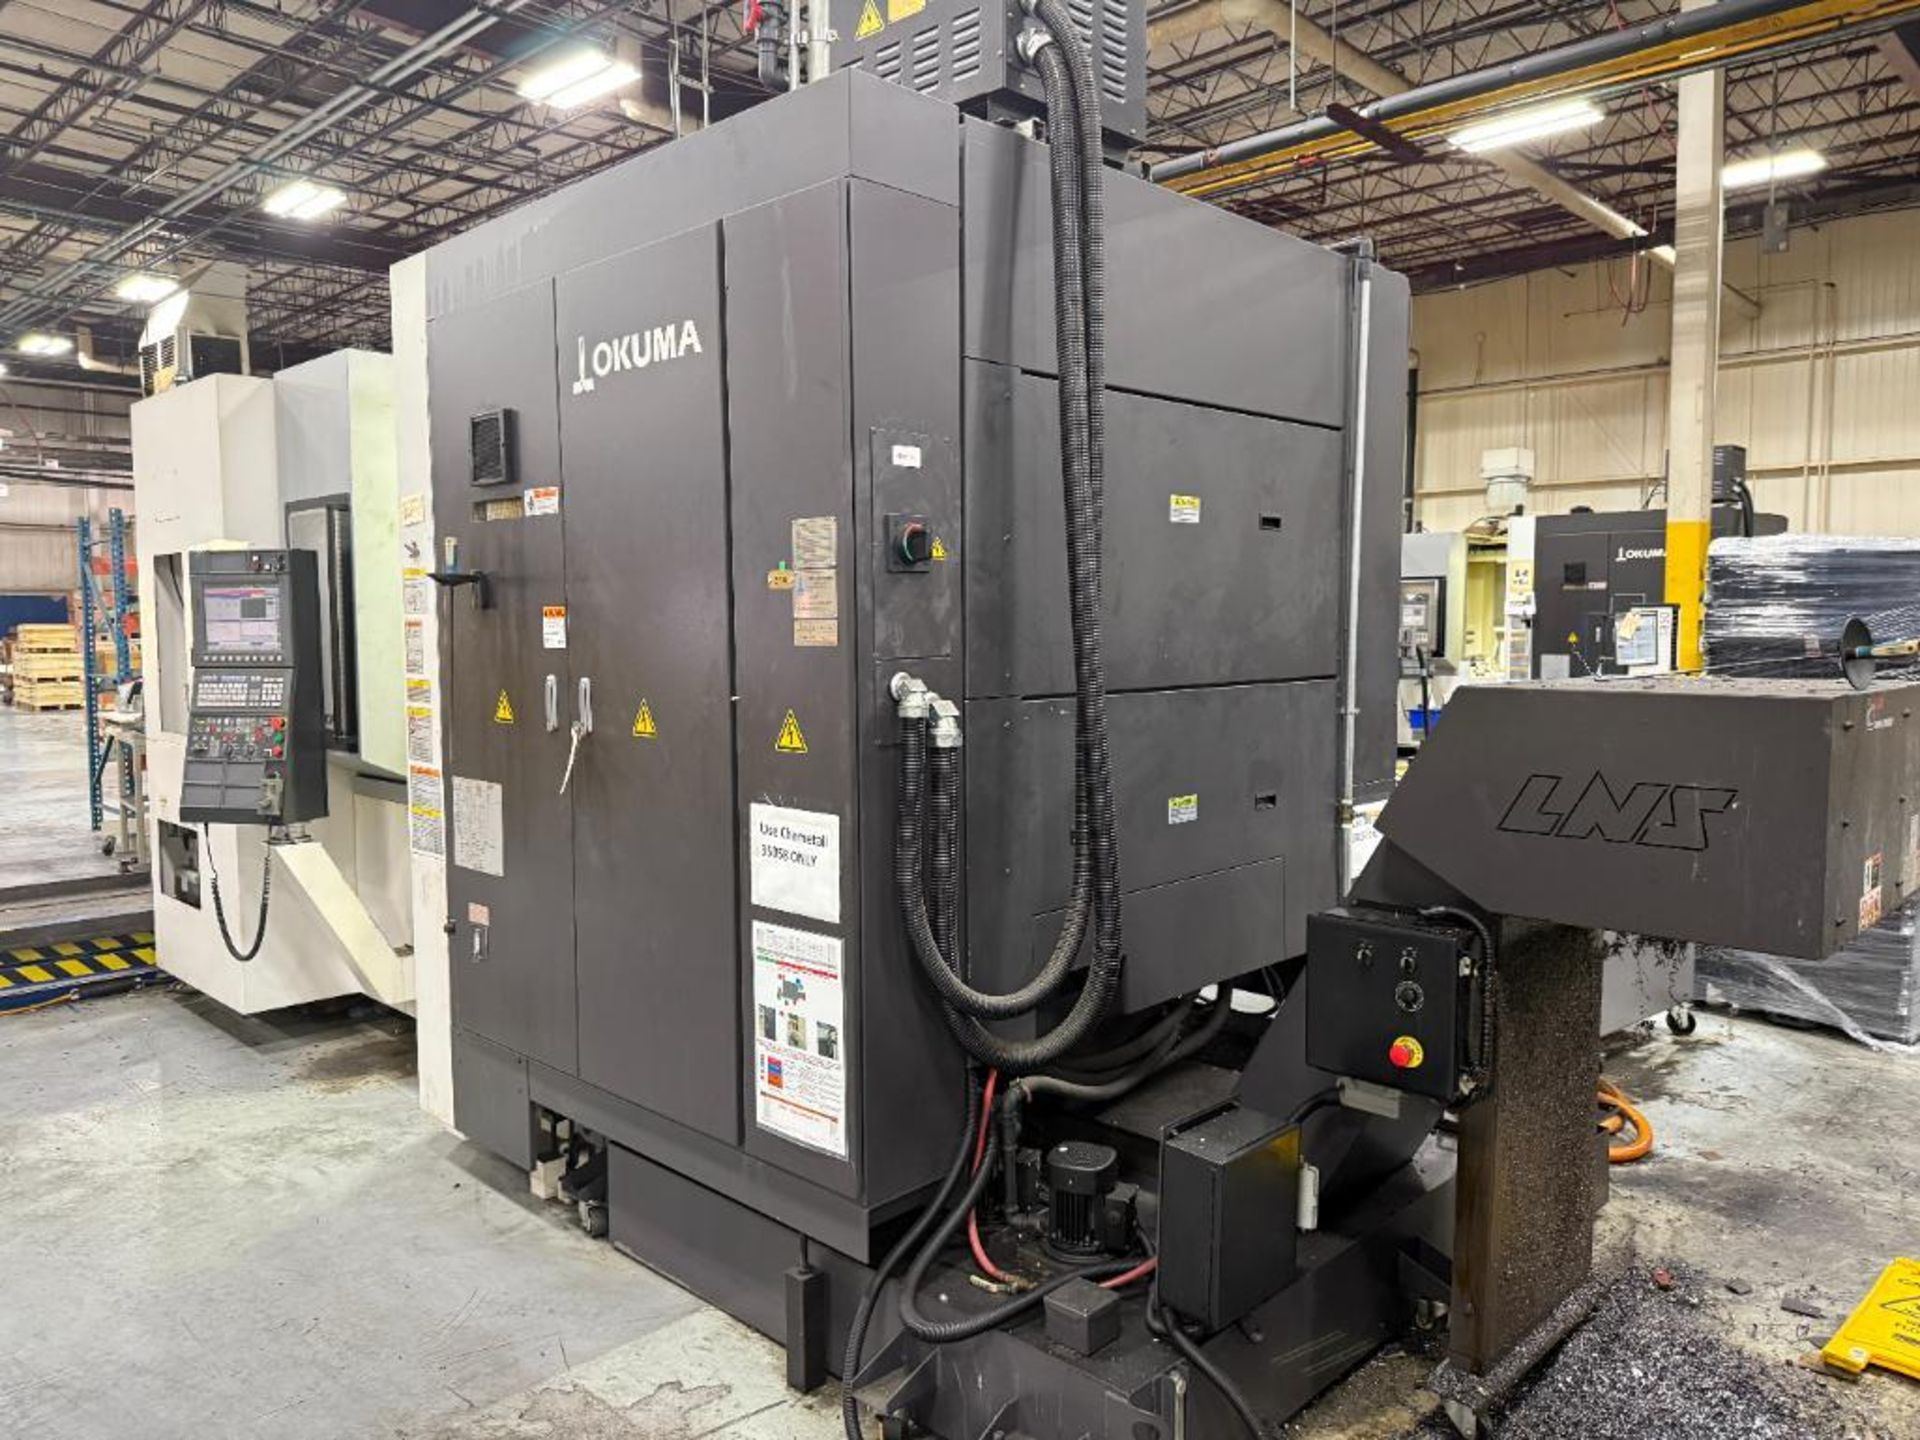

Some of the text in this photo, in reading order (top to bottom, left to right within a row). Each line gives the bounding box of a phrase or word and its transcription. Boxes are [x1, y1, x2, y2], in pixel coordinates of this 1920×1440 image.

[592, 320, 702, 377] OKUMA
[1625, 547, 1668, 559] OKUM
[1497, 770, 1738, 851] LNS
[760, 821, 778, 838] Use
[790, 851, 818, 867] ONLY
